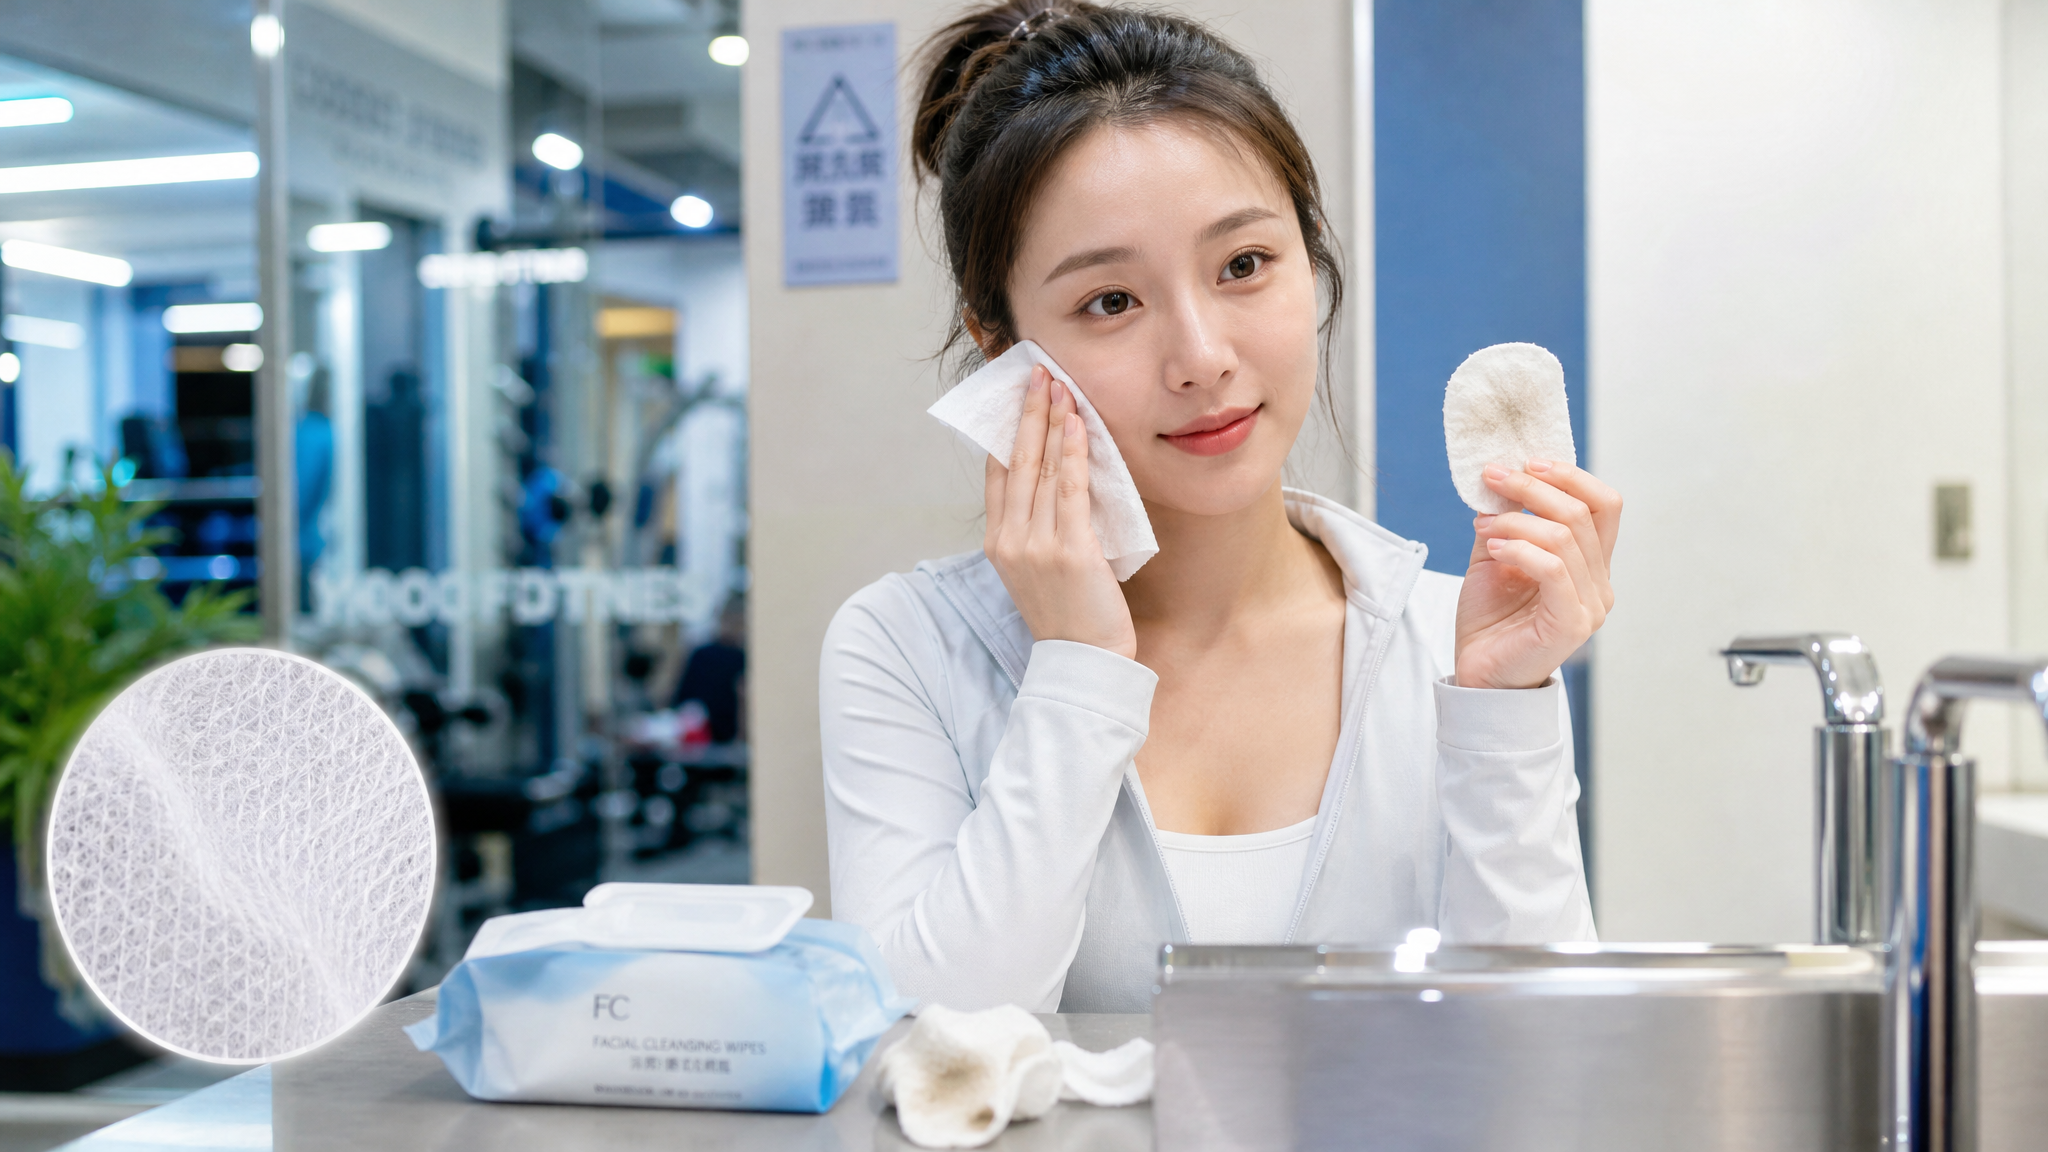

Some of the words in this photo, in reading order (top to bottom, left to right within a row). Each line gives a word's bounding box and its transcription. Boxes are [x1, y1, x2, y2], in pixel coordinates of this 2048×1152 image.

[593, 994, 631, 1021] FC
[593, 1035, 639, 1051] FACIAL
[642, 1037, 722, 1054] CLEANSING
[724, 1040, 767, 1056] WIPES
